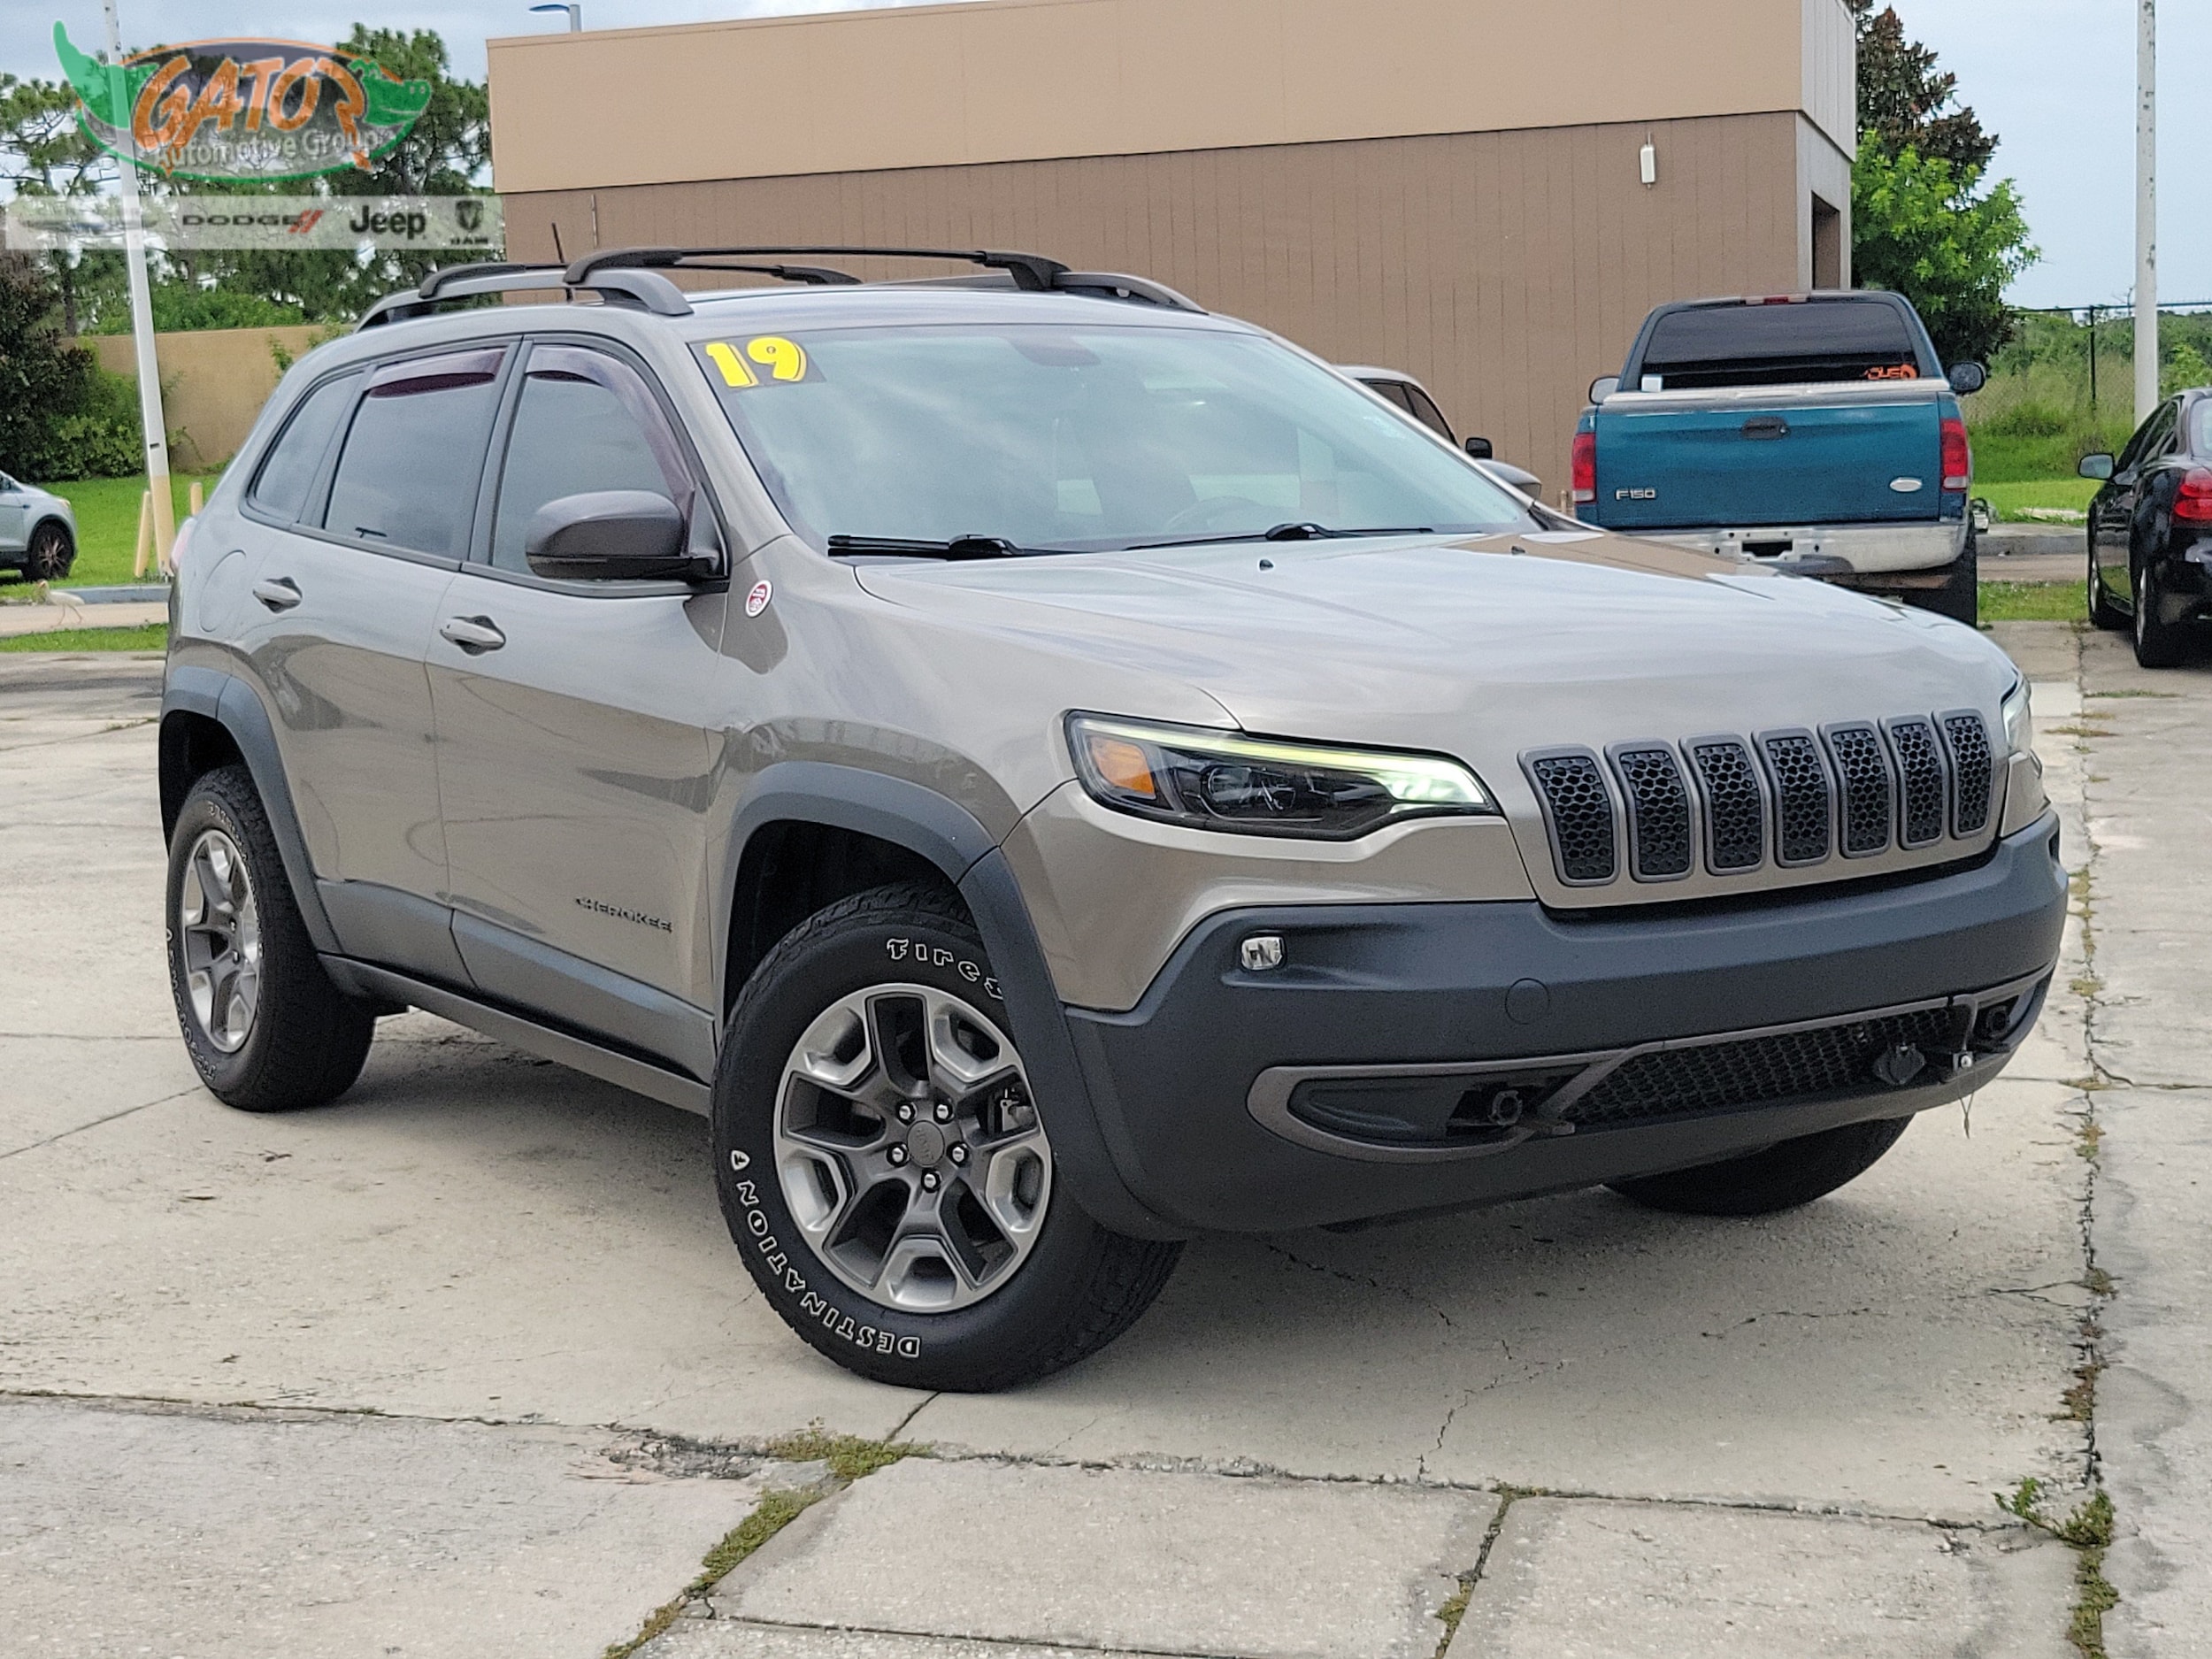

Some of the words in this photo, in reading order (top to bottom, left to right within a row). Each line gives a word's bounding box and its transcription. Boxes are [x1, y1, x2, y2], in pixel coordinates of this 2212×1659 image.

[705, 336, 807, 388] 19
[1616, 488, 1655, 501] F150
[887, 938, 1004, 1000] Fires
[736, 1179, 921, 1358] DESTINATION
